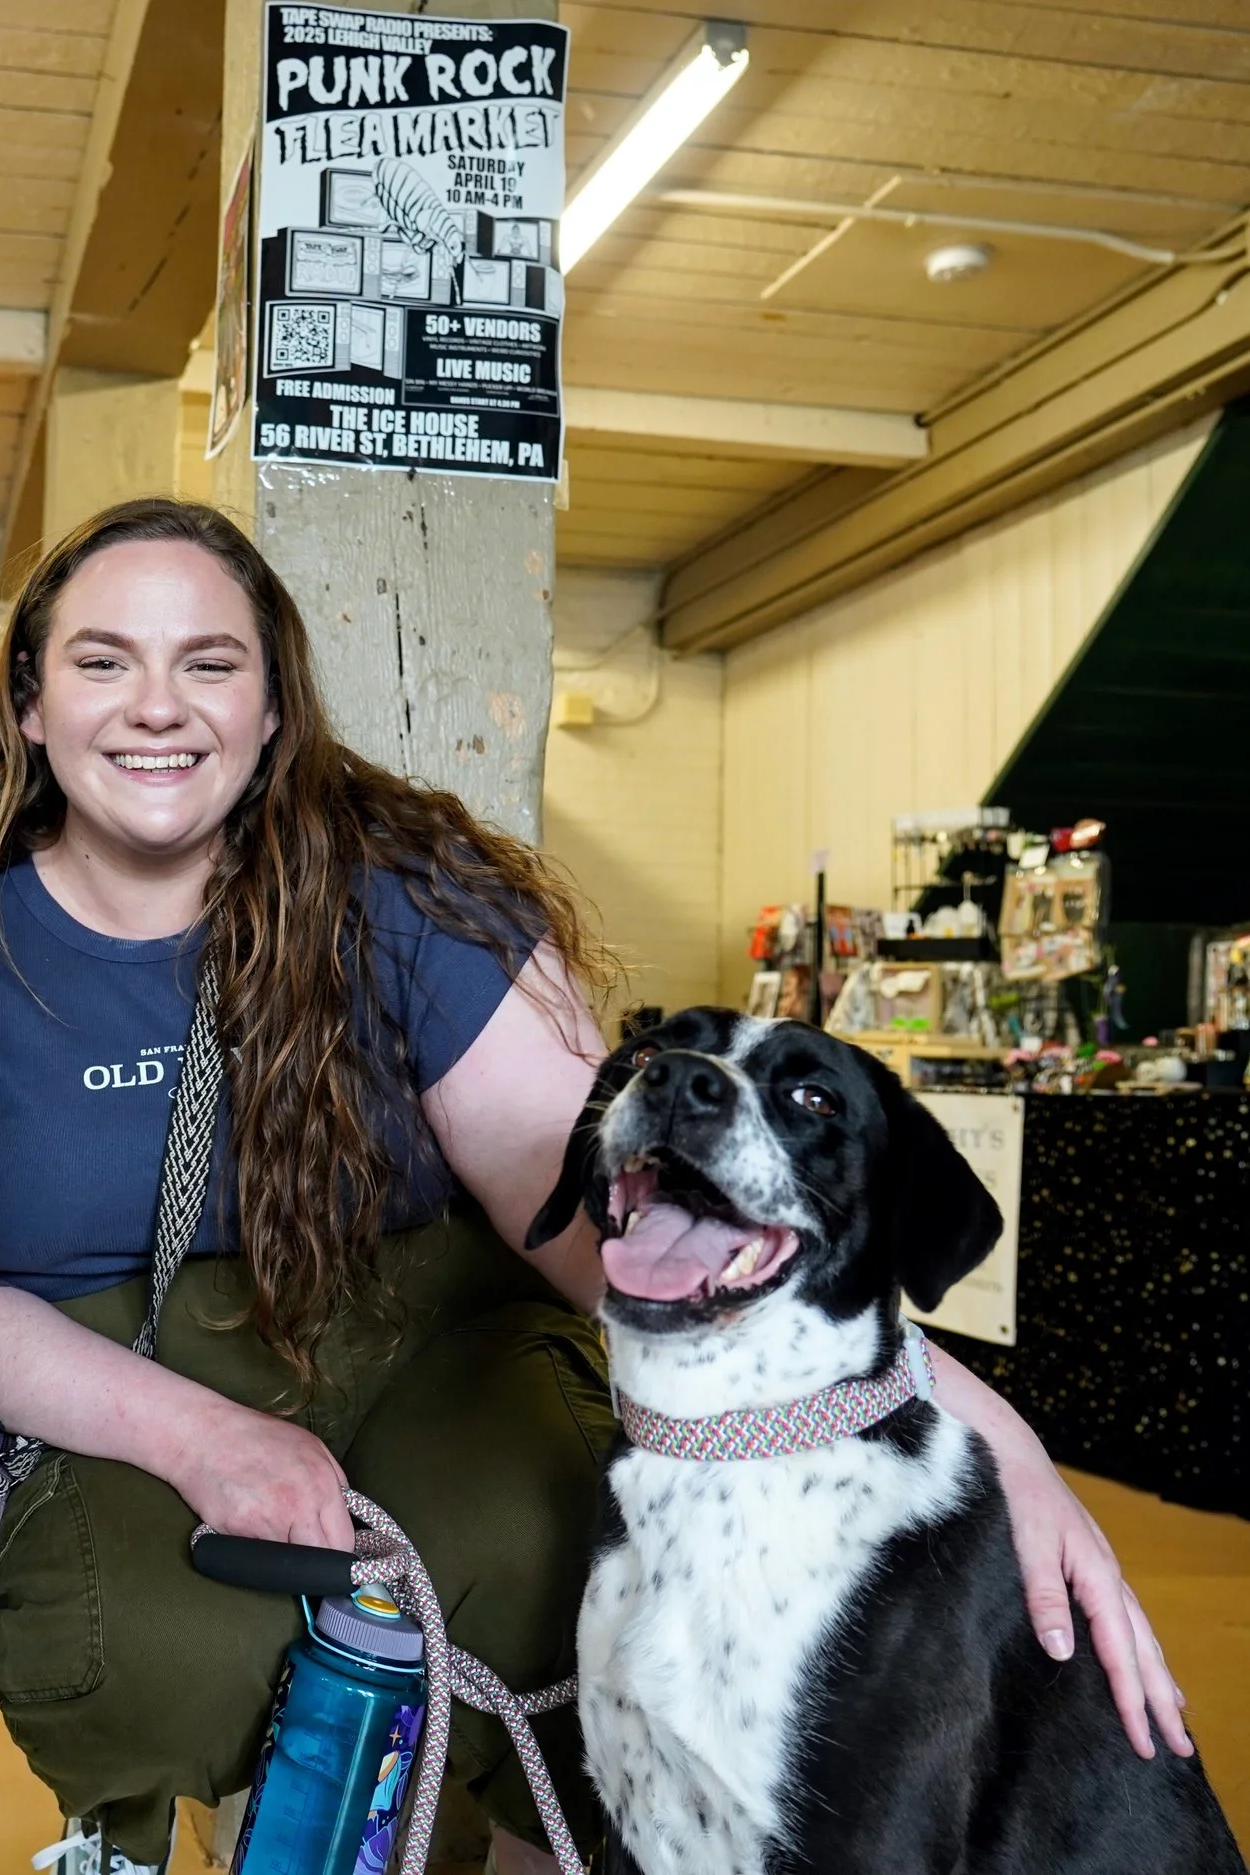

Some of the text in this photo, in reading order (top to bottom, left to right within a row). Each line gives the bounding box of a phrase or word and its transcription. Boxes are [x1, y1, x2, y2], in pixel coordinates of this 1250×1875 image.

[280, 8, 493, 42] TAPE SWAP RADIO PRESENTS:
[284, 26, 432, 55] 2025 LEHIGH VALLEY
[276, 44, 557, 111] PUNK ROCK
[275, 104, 561, 165] FLEA MARKET
[448, 154, 526, 175] SATURDAY
[454, 172, 517, 193] APRIL 19
[446, 189, 462, 204] 10
[503, 193, 524, 209] PM
[425, 314, 542, 343] 50+ VENDORS
[436, 358, 531, 384] LIVE MUSIC
[276, 379, 395, 405] FREE ADMISSION
[330, 405, 479, 438] THE ICE HOUSE
[260, 424, 545, 468] 56 RIVER ST, BETHLEHEM, PA
[140, 1044, 187, 1056] SAN FRA
[83, 1060, 164, 1090] OLD
